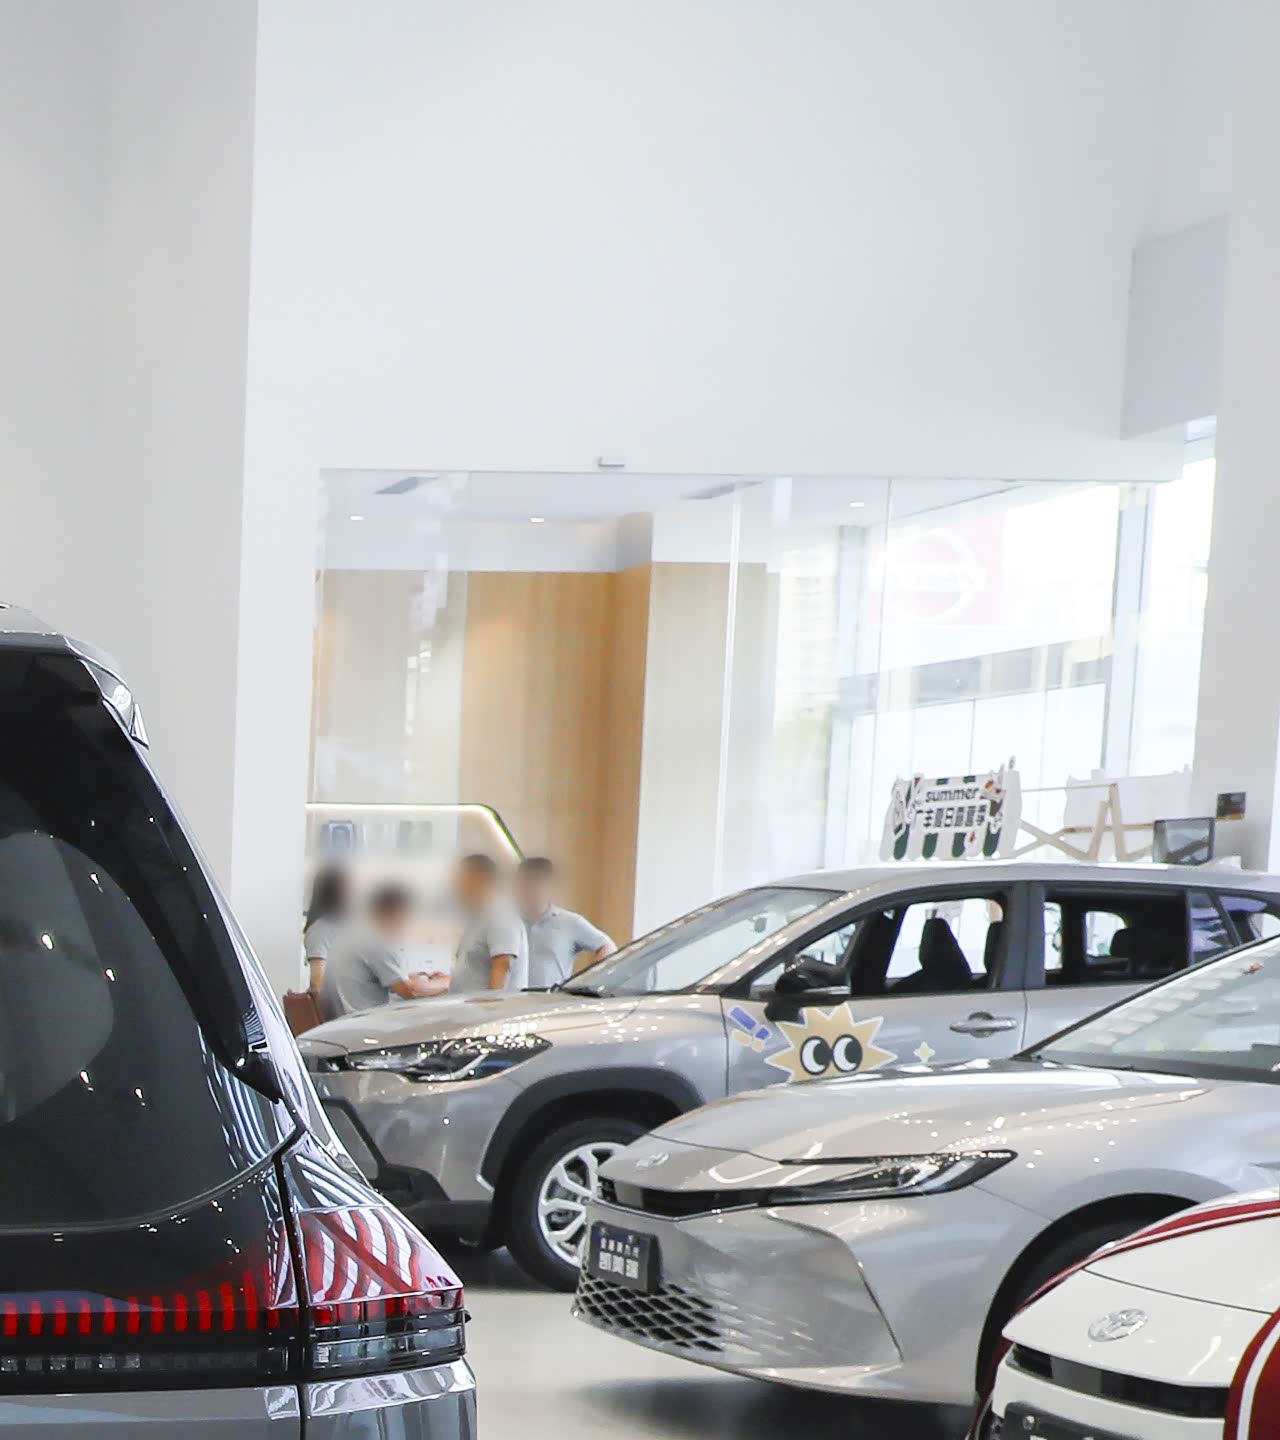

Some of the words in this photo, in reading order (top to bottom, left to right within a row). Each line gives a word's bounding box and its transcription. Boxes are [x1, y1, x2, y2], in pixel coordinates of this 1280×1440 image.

[926, 787, 980, 802] summer
[599, 1251, 639, 1279] 凯美瑞
